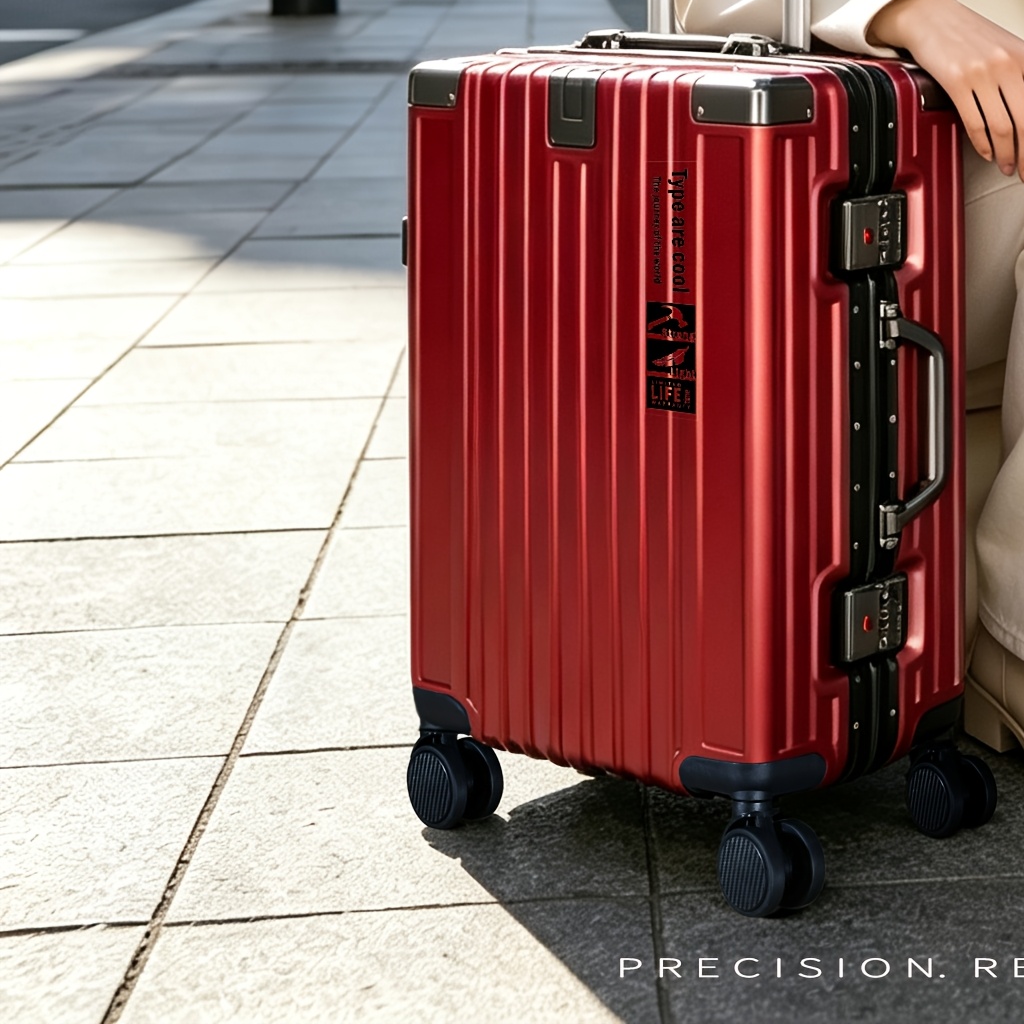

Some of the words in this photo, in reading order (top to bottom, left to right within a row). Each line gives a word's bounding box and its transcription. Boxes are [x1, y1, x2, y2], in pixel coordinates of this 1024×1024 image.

[668, 169, 688, 212] Type
[671, 216, 685, 247] are
[672, 251, 690, 293] cool
[651, 384, 682, 403] LIFE
